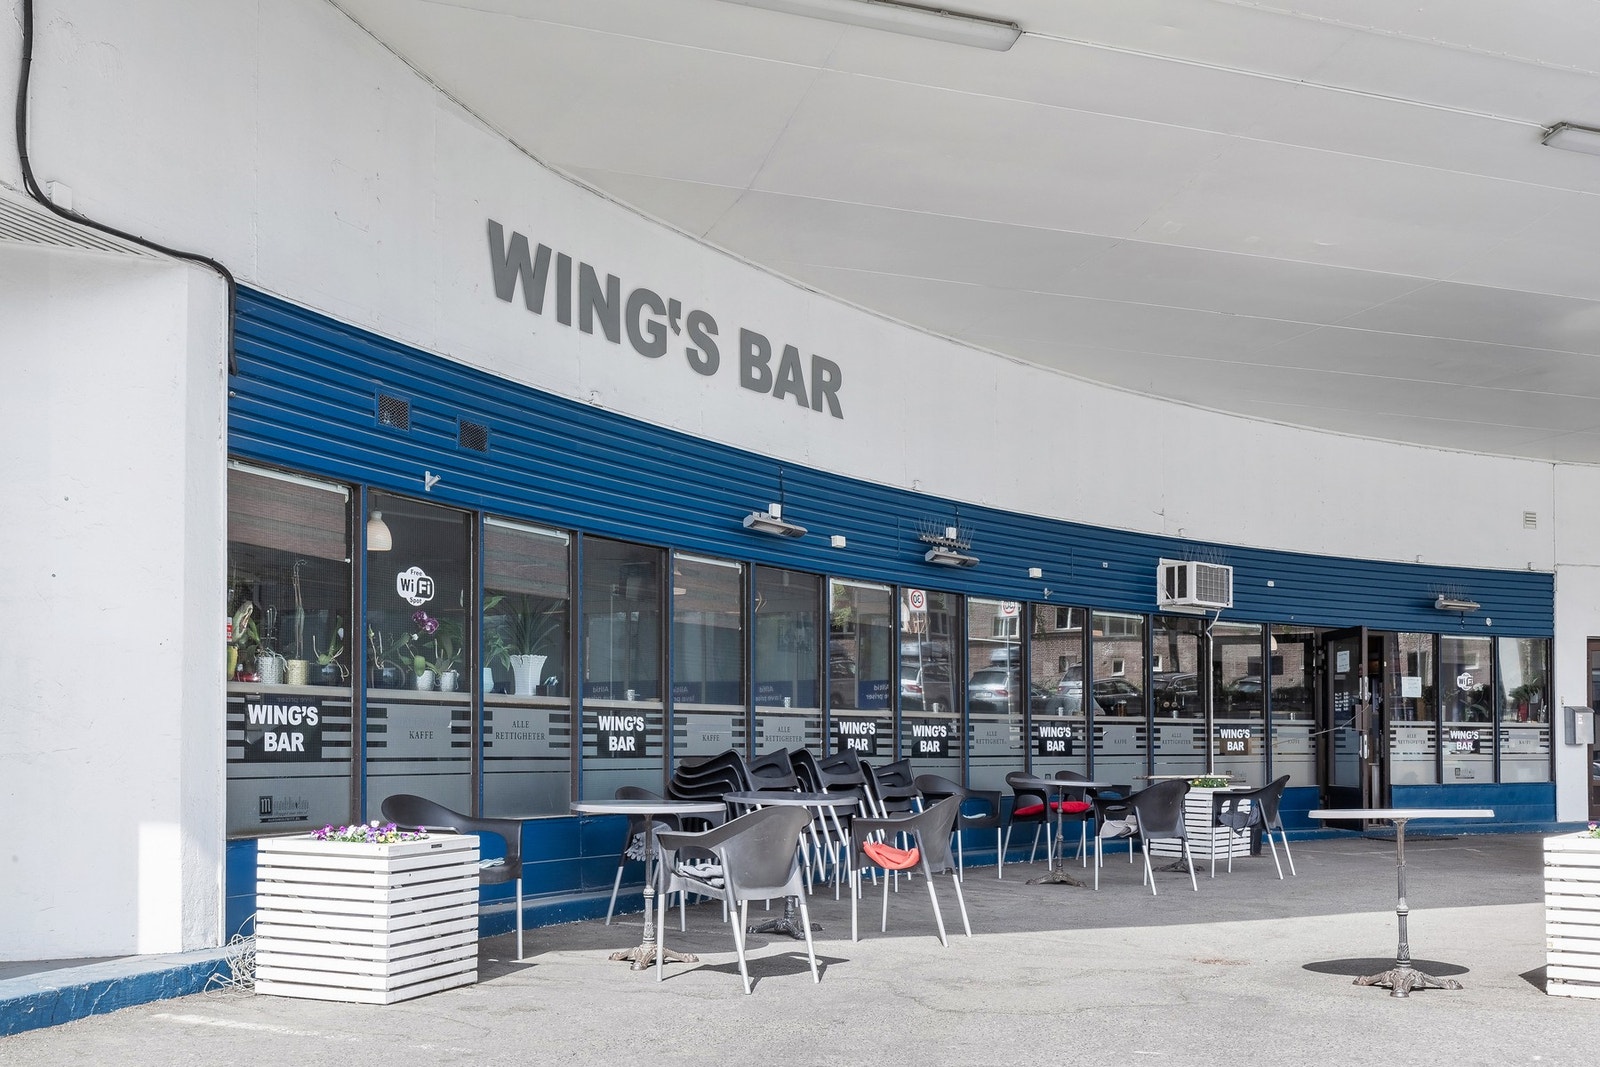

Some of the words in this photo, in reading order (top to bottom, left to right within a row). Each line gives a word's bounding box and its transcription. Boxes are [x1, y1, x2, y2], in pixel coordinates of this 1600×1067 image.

[488, 218, 720, 376] WING'S
[740, 327, 844, 420] BAR
[247, 703, 319, 726] WING'S
[512, 720, 530, 729] ALLE
[598, 716, 645, 731] WING'S
[839, 721, 876, 735] WING'S
[409, 730, 434, 740] KAFFE
[495, 731, 546, 741] RETTIGHETER
[912, 724, 947, 738] WING'S
[1039, 726, 1072, 738] WING'S
[1220, 728, 1251, 739] WING'S
[1450, 730, 1479, 739] WING'S
[264, 732, 305, 752] BAR
[608, 736, 636, 751] BAR
[847, 738, 869, 751] BAR
[920, 740, 941, 753] BAR
[1046, 740, 1066, 752] BAR
[1227, 741, 1245, 751] BAR
[1456, 741, 1474, 751] BAR
